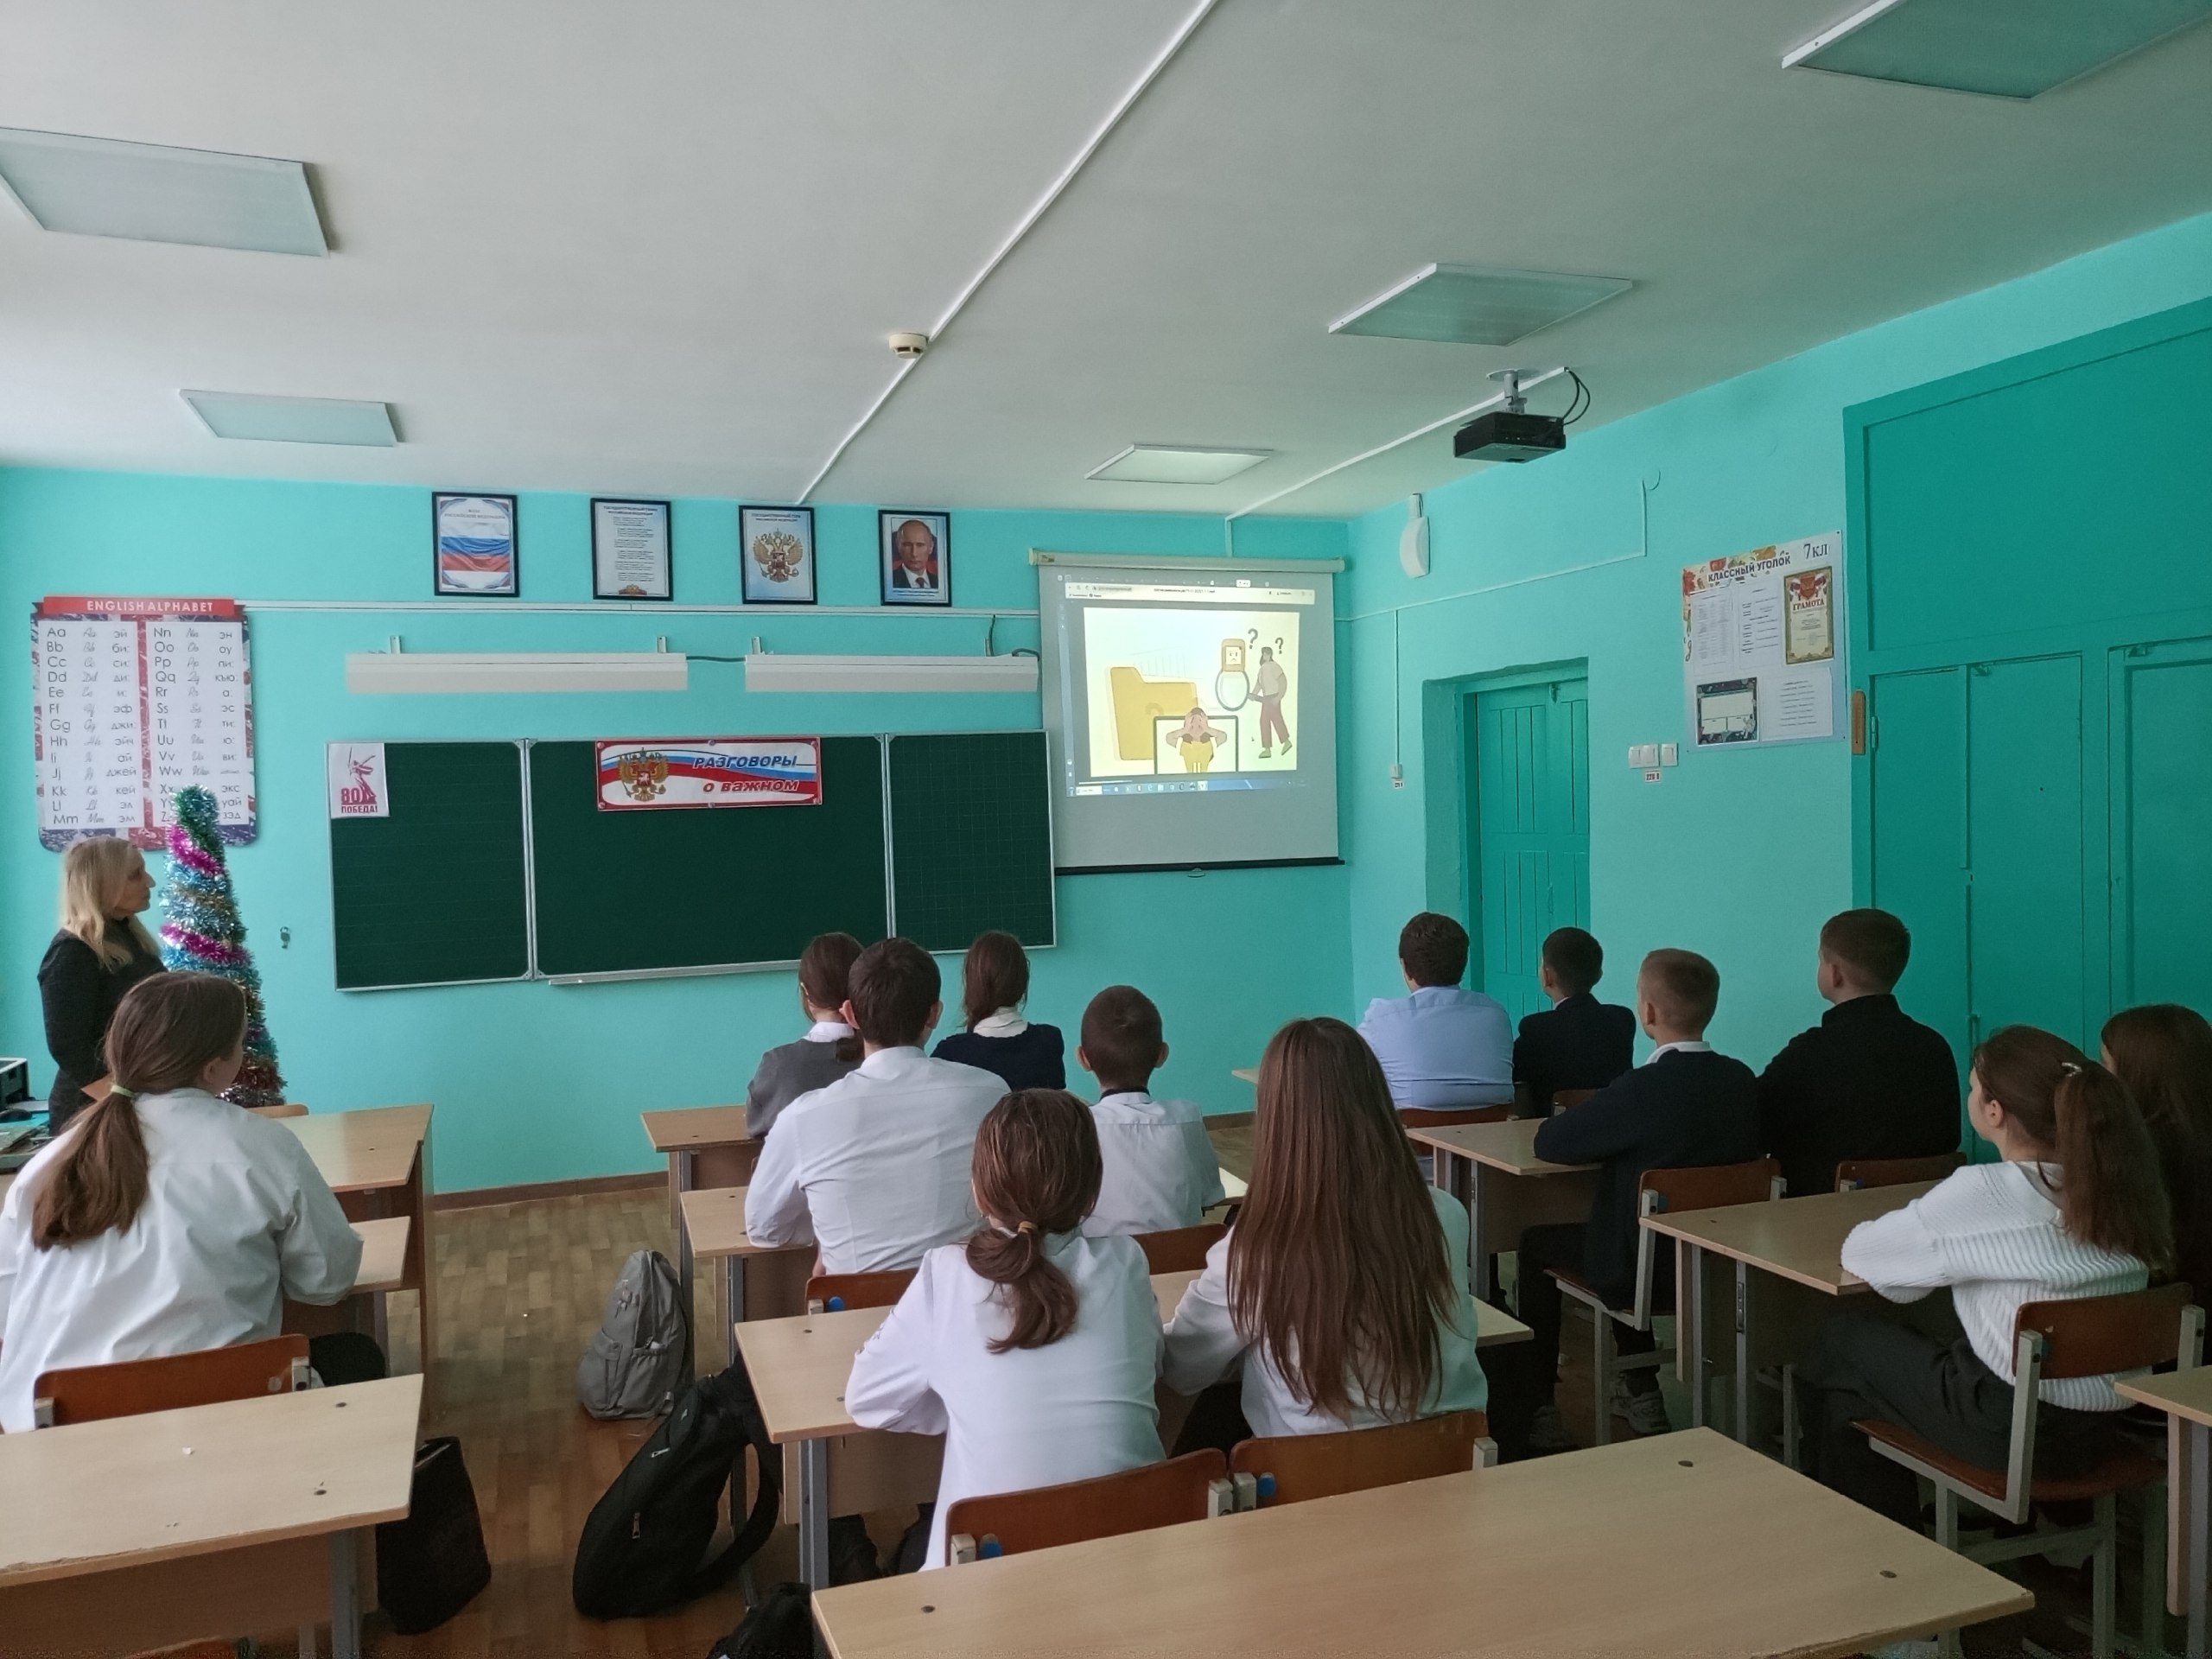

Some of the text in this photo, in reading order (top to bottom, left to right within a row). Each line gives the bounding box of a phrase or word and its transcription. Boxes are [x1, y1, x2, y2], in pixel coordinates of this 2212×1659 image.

[1707, 556, 1791, 582] КЛАССНЫЙ УГОЛОК
[86, 601, 213, 613] ENGLISH ALPHABET
[1793, 598, 1825, 611] ГРАМОТА
[47, 627, 66, 638] Aa
[113, 629, 128, 639] эй
[154, 627, 171, 638] Nn
[219, 631, 232, 639] эн
[47, 641, 64, 652] Bb
[154, 641, 175, 653] Oo
[219, 646, 232, 655] оу
[48, 656, 67, 667] Cc
[155, 656, 171, 670] Pp
[48, 671, 67, 683] Dd
[156, 671, 176, 684] Qq
[48, 686, 65, 698] Ee
[156, 686, 168, 697] Rr
[113, 705, 133, 714] эф
[156, 702, 169, 714] Ss
[50, 719, 71, 734] Gg
[50, 736, 67, 747] Hh
[157, 734, 175, 746] Uu
[118, 752, 132, 762] ай
[159, 751, 175, 761] Vv
[692, 755, 798, 770] РАЗГОВОРЫ
[52, 767, 61, 781] Jj
[105, 766, 137, 778] джей
[159, 766, 183, 776] Ww
[52, 785, 67, 797] Kk
[116, 785, 136, 795] кей
[221, 785, 240, 793] экс
[221, 795, 242, 807] уай
[340, 787, 361, 804] 80
[52, 800, 61, 812] Ll
[54, 814, 79, 824] Mm
[118, 815, 136, 823] эм
